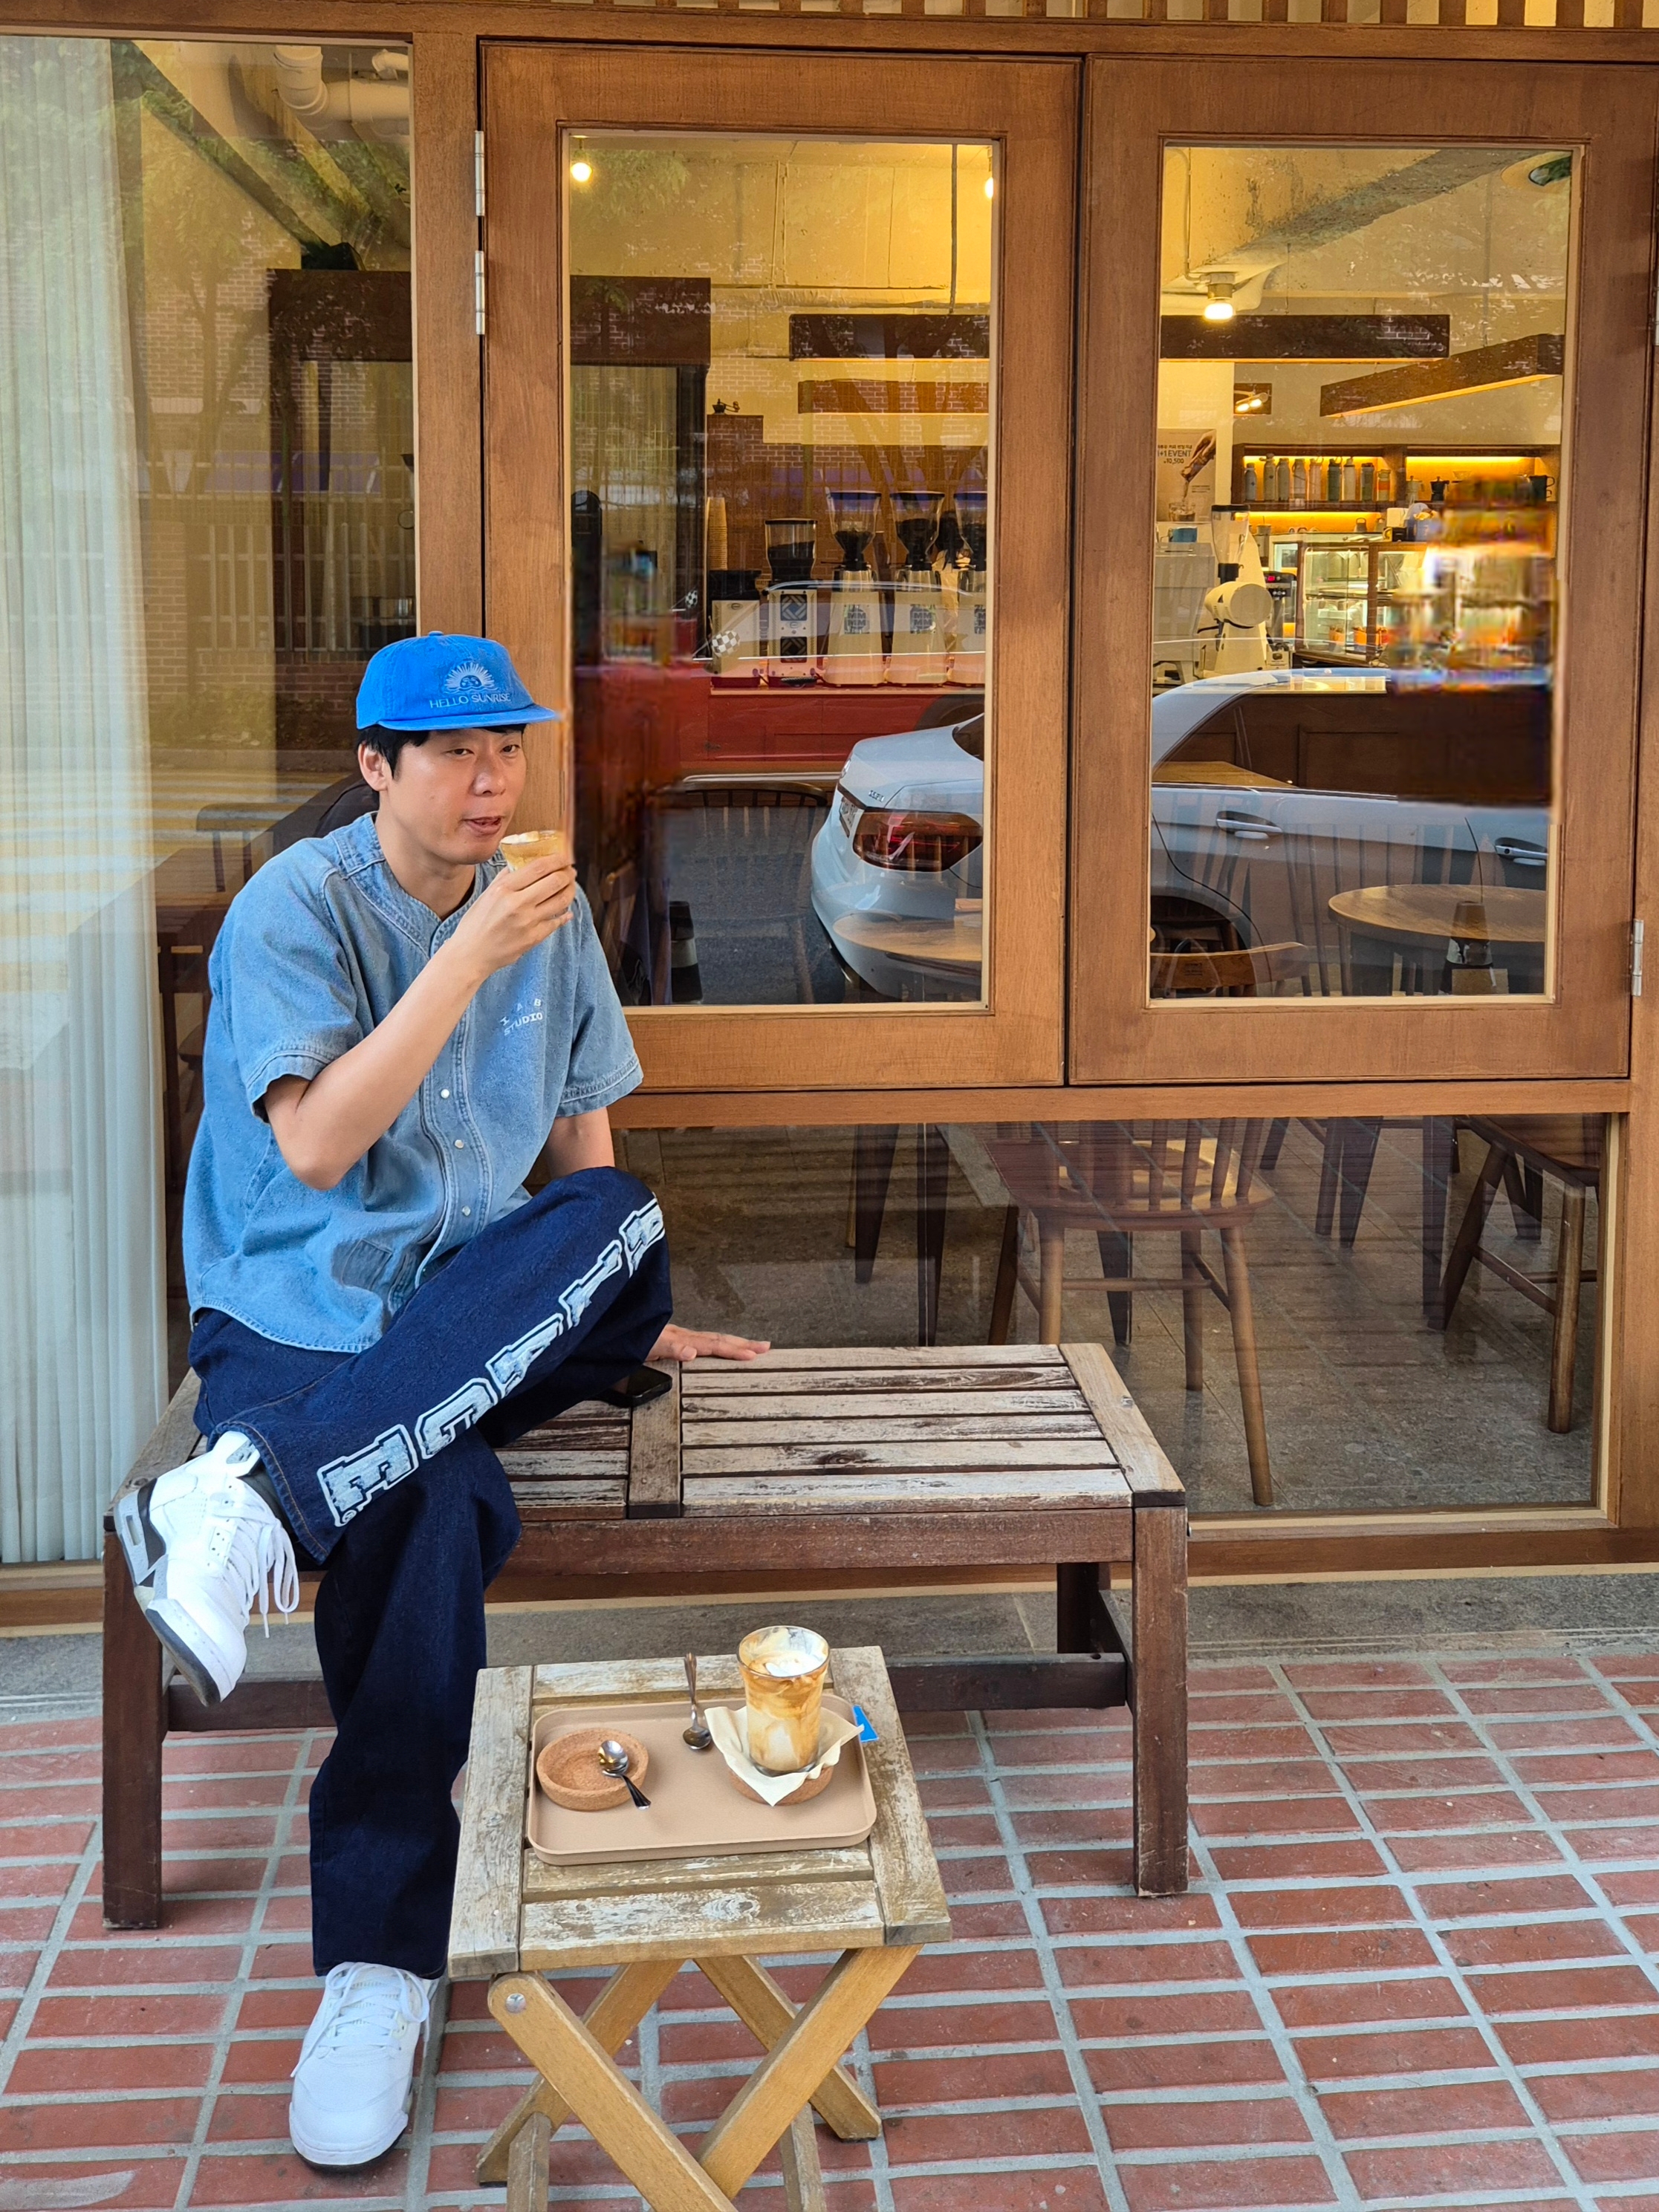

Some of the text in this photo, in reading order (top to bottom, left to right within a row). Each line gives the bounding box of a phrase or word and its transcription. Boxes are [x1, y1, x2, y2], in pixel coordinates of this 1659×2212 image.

[429, 692, 511, 709] HELLO SUNRISE
[504, 1012, 543, 1036] STUDIO
